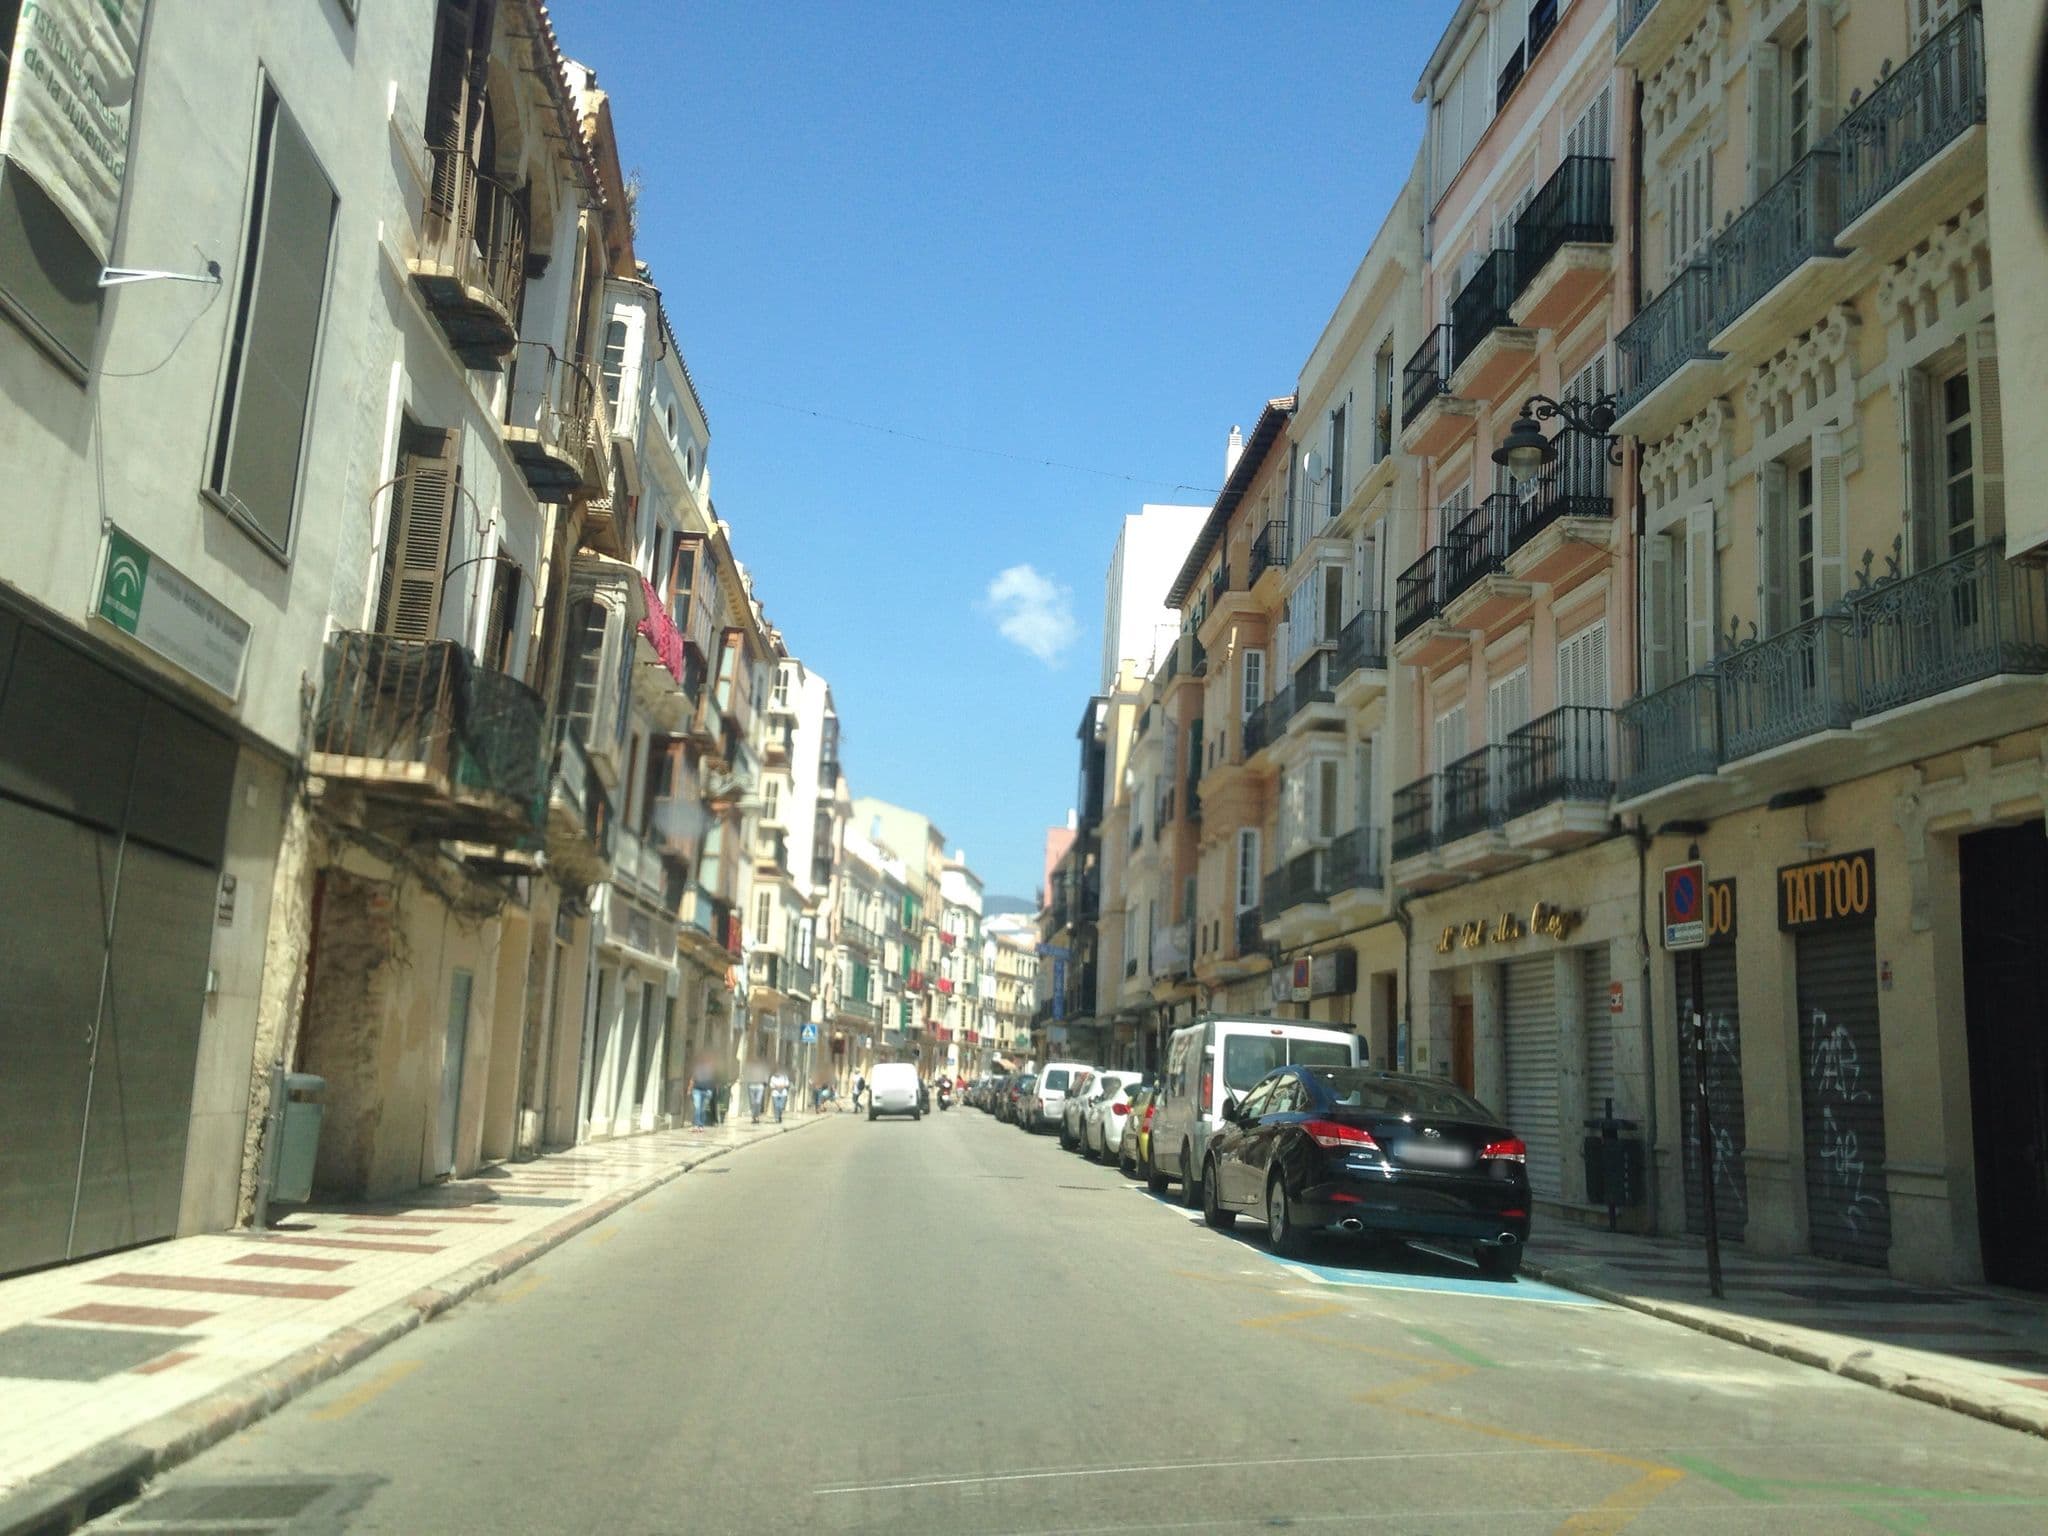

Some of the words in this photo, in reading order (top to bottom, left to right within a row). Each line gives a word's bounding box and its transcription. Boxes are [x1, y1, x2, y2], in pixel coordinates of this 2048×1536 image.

[24, 48, 45, 80] de
[46, 69, 61, 102] la
[1782, 856, 1868, 924] TATTOO
